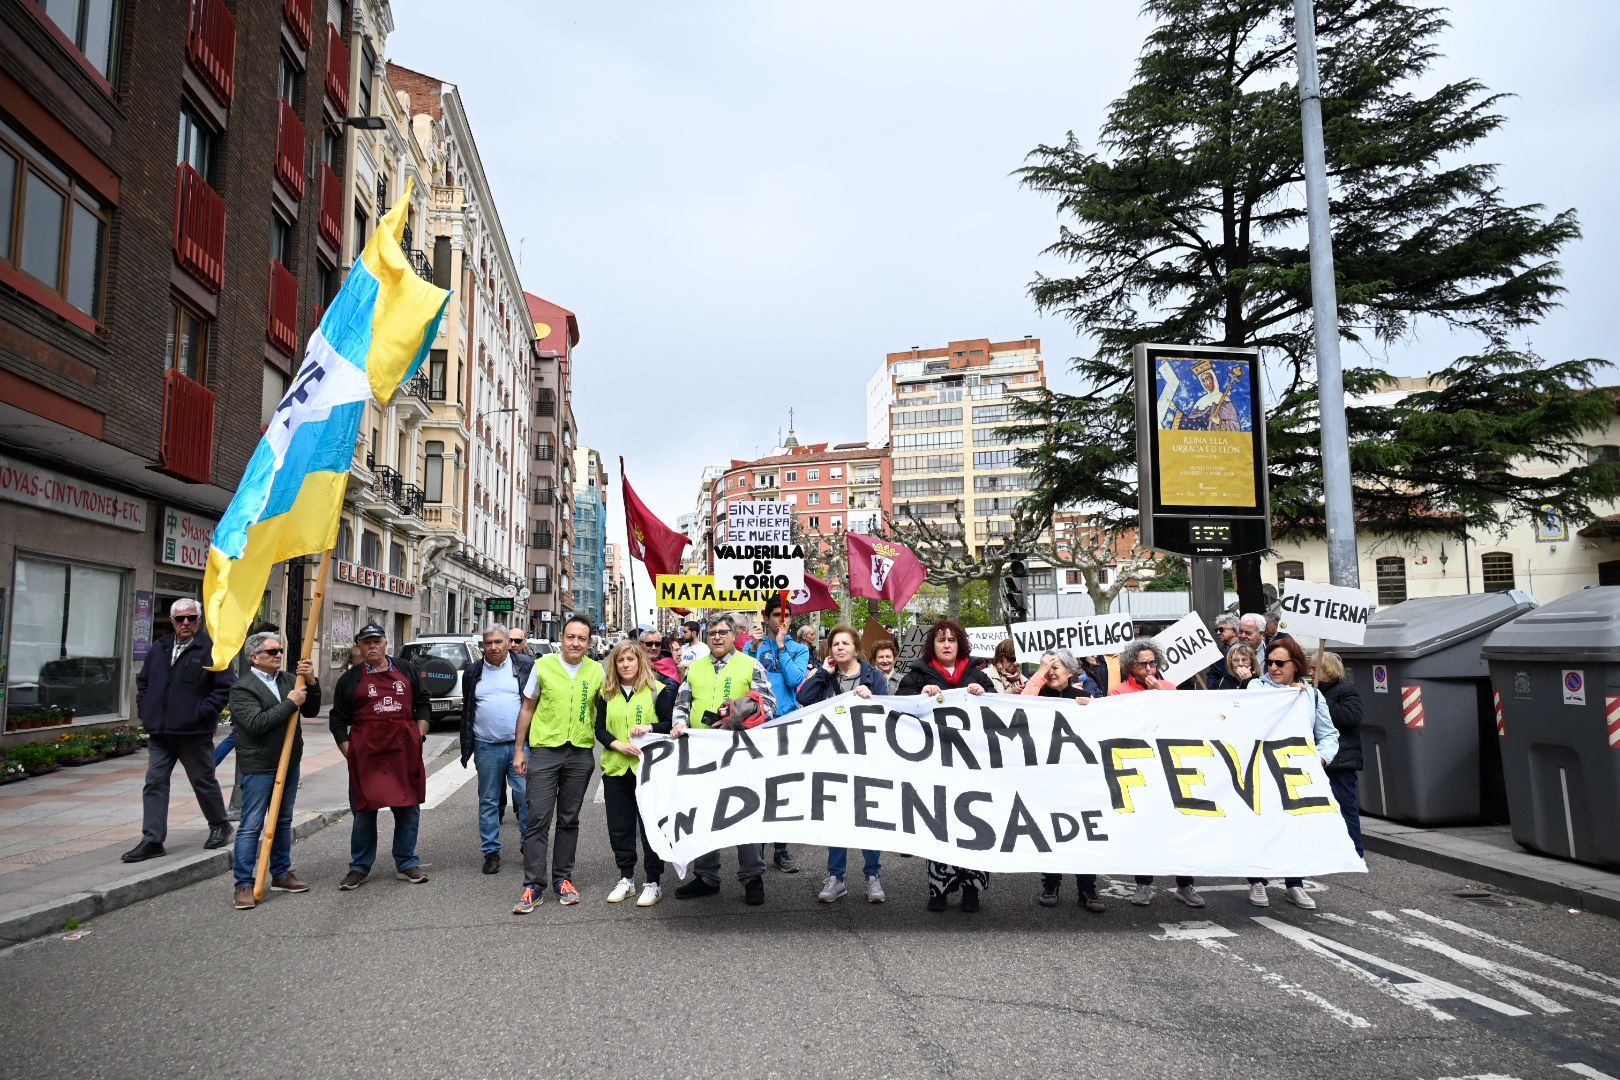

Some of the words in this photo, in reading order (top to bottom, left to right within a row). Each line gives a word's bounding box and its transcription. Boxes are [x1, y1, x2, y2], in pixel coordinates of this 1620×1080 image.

[729, 502, 755, 516] SIN
[758, 504, 790, 516] FEVE
[729, 518, 745, 528] LA
[746, 515, 790, 528] RIBERA
[728, 530, 747, 542] SE
[749, 529, 790, 542] MUERE
[714, 544, 804, 560] VALDERILLA
[753, 560, 772, 575] DE
[732, 574, 790, 590] TORIO
[1280, 593, 1368, 625] CISTIERNA
[1013, 619, 1135, 654] VALDEPIÉLAGO
[428, 672, 455, 680] SUZUKI
[579, 680, 589, 724] GREENPEACE
[639, 704, 1099, 786] PLATAFORMA
[710, 771, 1053, 853] DEFENSA
[1050, 809, 1109, 843] DE
[1097, 736, 1339, 817] FEVE
